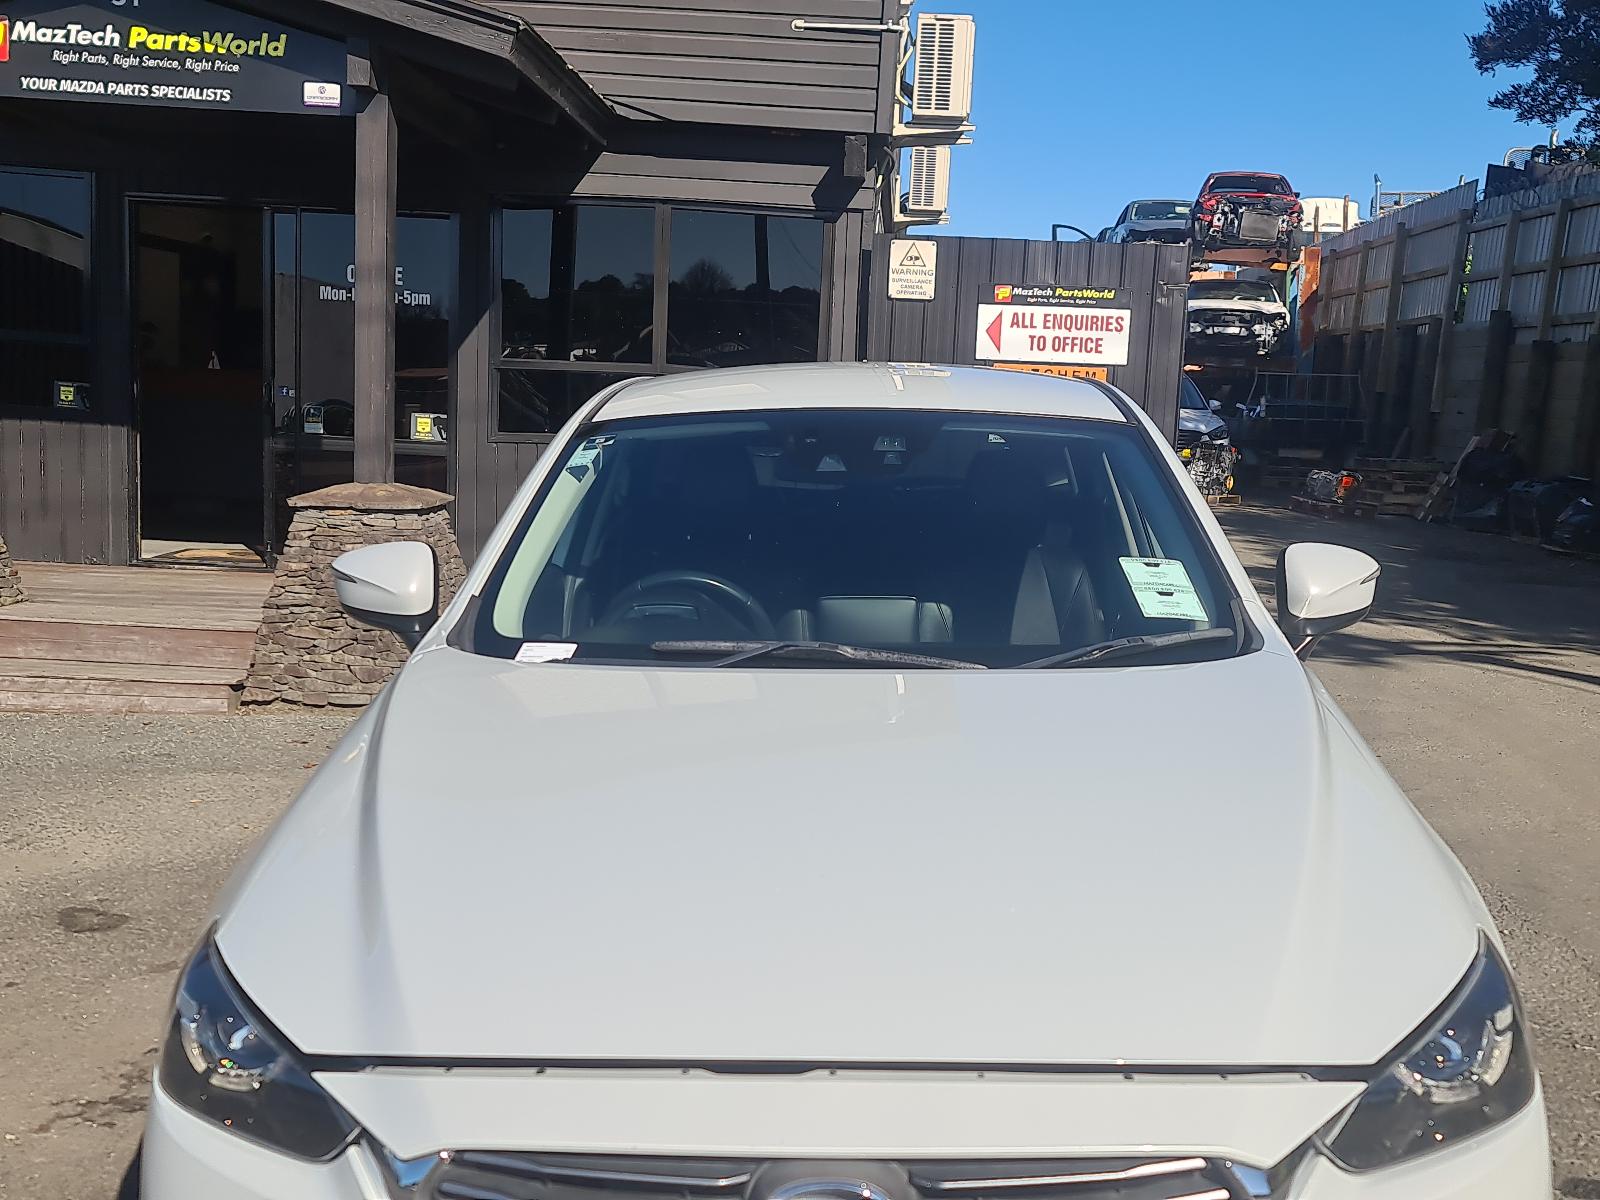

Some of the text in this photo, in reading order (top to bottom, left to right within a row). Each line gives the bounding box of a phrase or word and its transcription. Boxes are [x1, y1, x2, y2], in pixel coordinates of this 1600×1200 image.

[10, 20, 287, 57] MazTech PartsWorld
[52, 49, 240, 73] Right Parts, Right Service, Right Price
[20, 76, 231, 101] YOUR MAZDA PARTS SPECIALISTS
[891, 267, 934, 277] WARNING
[1013, 287, 1053, 297] MazTech
[1055, 288, 1116, 299] PartsWorld
[1010, 312, 1124, 333] ALL ENQUIRIES
[1029, 335, 1104, 354] TO OFFICE
